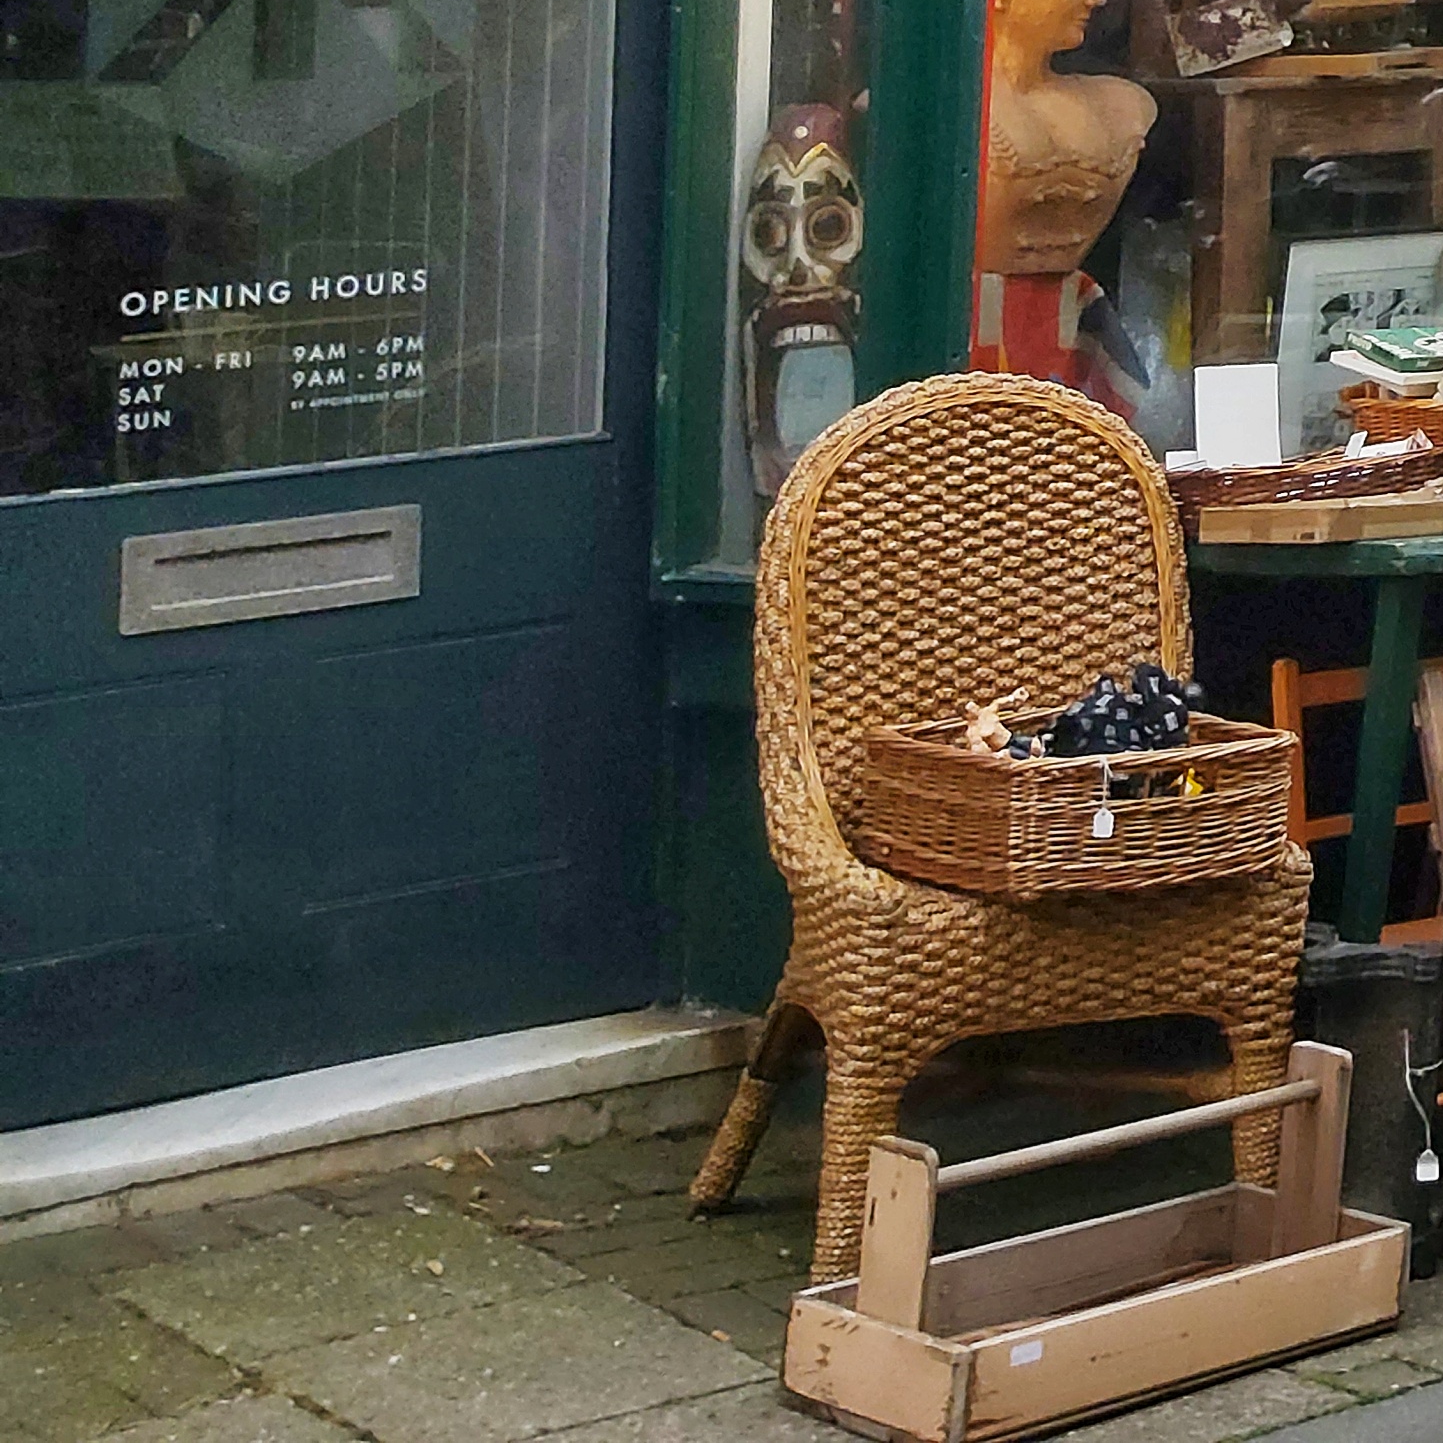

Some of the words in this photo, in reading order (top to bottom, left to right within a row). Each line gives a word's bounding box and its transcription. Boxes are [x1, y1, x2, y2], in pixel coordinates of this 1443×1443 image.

[120, 280, 292, 317] OPENING
[310, 268, 428, 301] HOURS
[119, 356, 184, 380] MON
[214, 351, 252, 370] FRI
[292, 343, 346, 363] 9AM
[376, 335, 424, 356] 6PM
[117, 383, 166, 407] SAT
[291, 367, 346, 390] 9AM
[375, 361, 423, 382] 5PM
[117, 410, 171, 433] SUN
